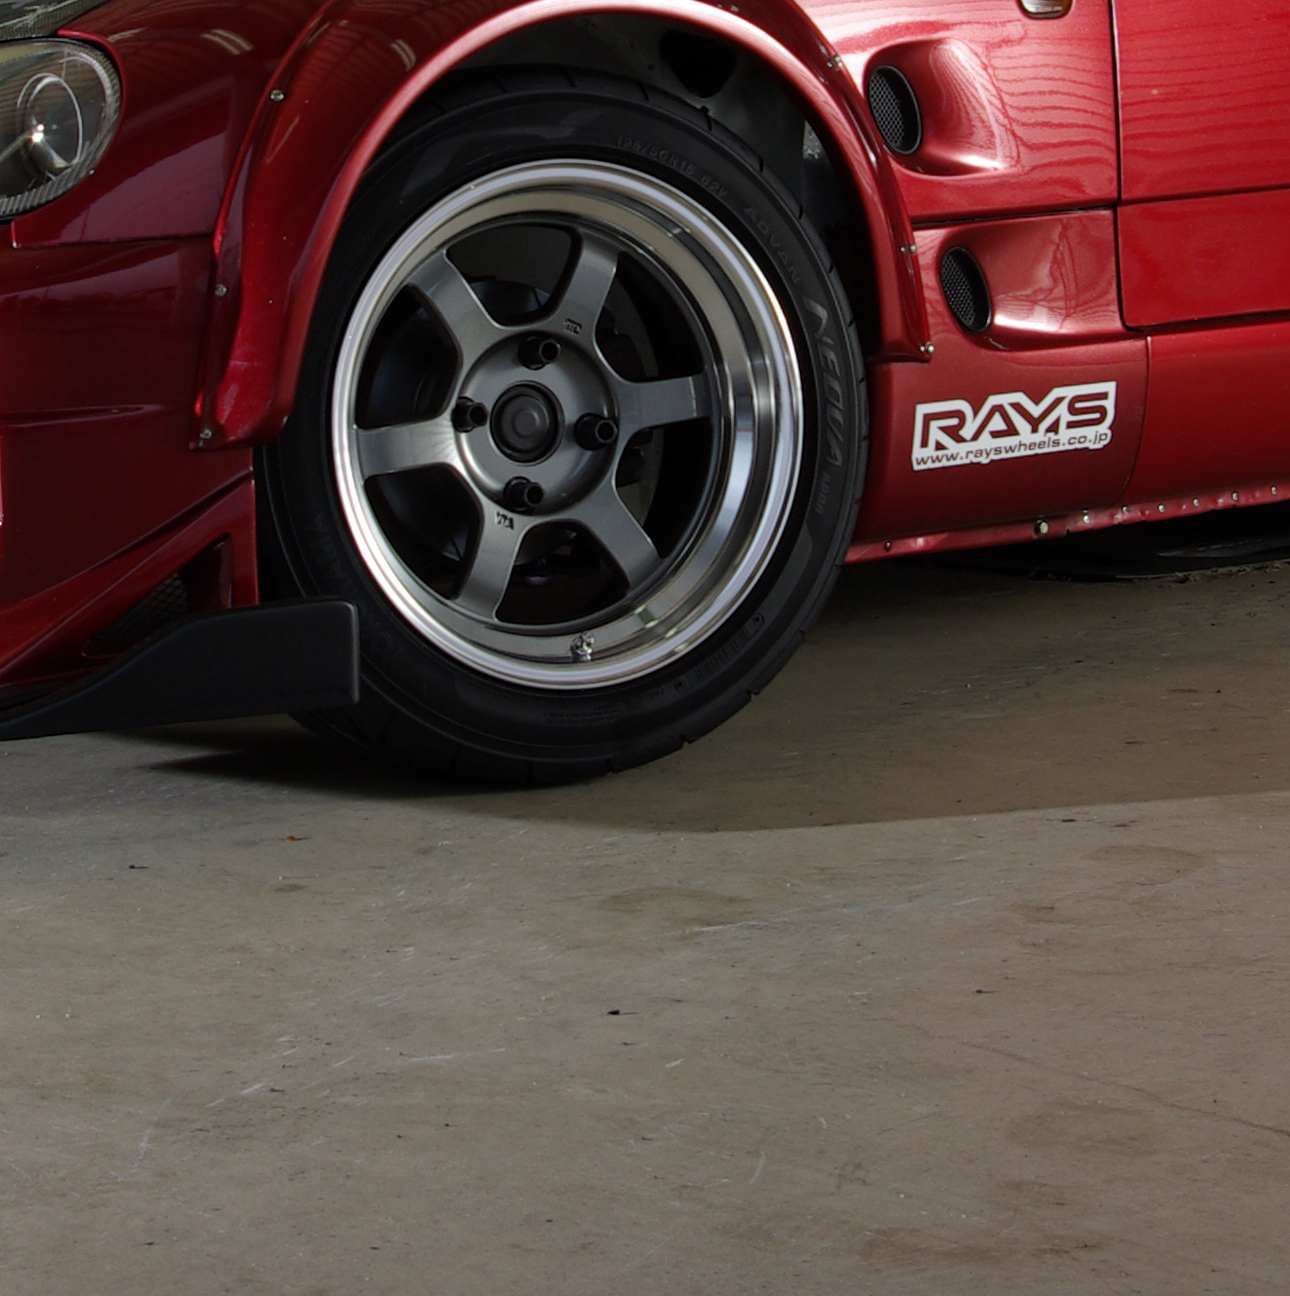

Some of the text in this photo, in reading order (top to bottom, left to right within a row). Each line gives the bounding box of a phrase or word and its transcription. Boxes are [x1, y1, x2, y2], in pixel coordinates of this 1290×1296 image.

[743, 206, 801, 285] ADVAN
[915, 430, 1109, 467] www.rayswheels.co.jp
[920, 391, 1110, 452] RAYS
